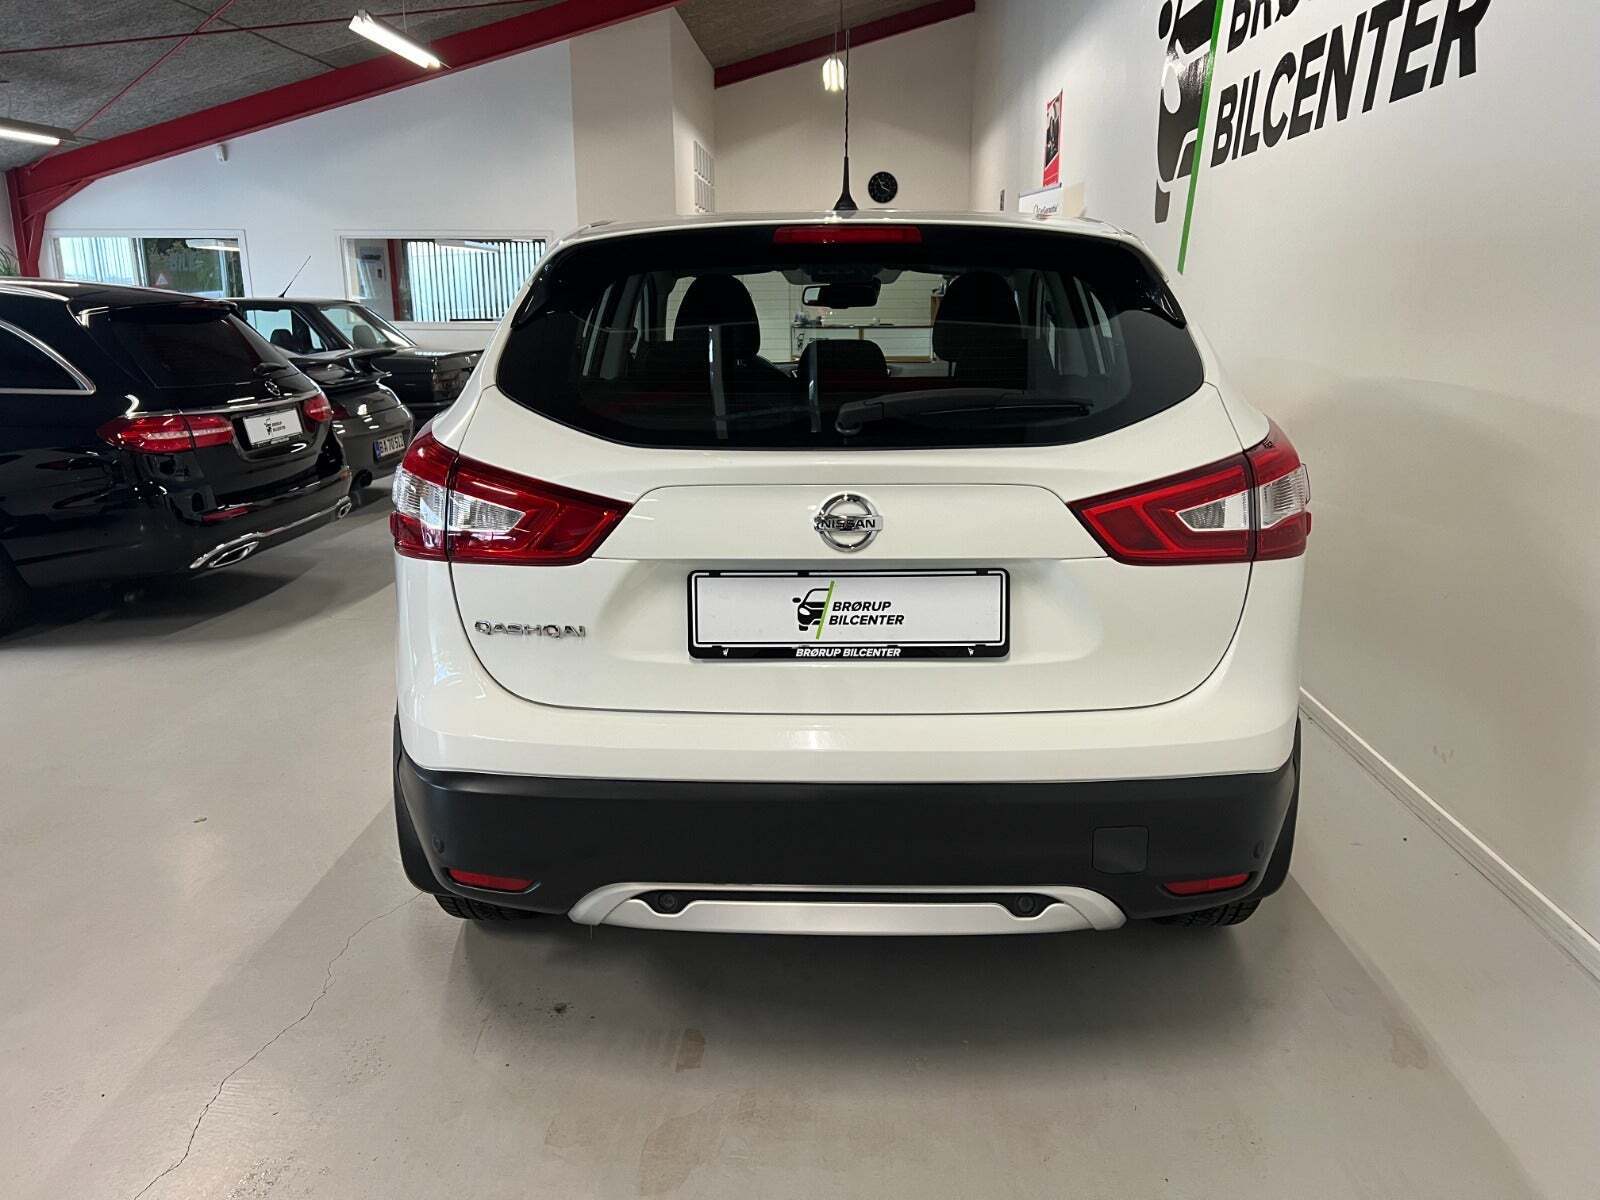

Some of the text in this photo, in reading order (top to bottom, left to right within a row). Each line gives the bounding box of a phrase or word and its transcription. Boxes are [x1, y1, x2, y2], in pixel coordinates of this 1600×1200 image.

[1211, 0, 1491, 168] BILCENTER
[820, 519, 876, 529] NISSAN
[832, 601, 892, 612] BRØRUP
[828, 614, 905, 625] BILCENTER
[475, 620, 586, 639] QASHQAI
[796, 648, 902, 657] BRØRUP BILCENTER
